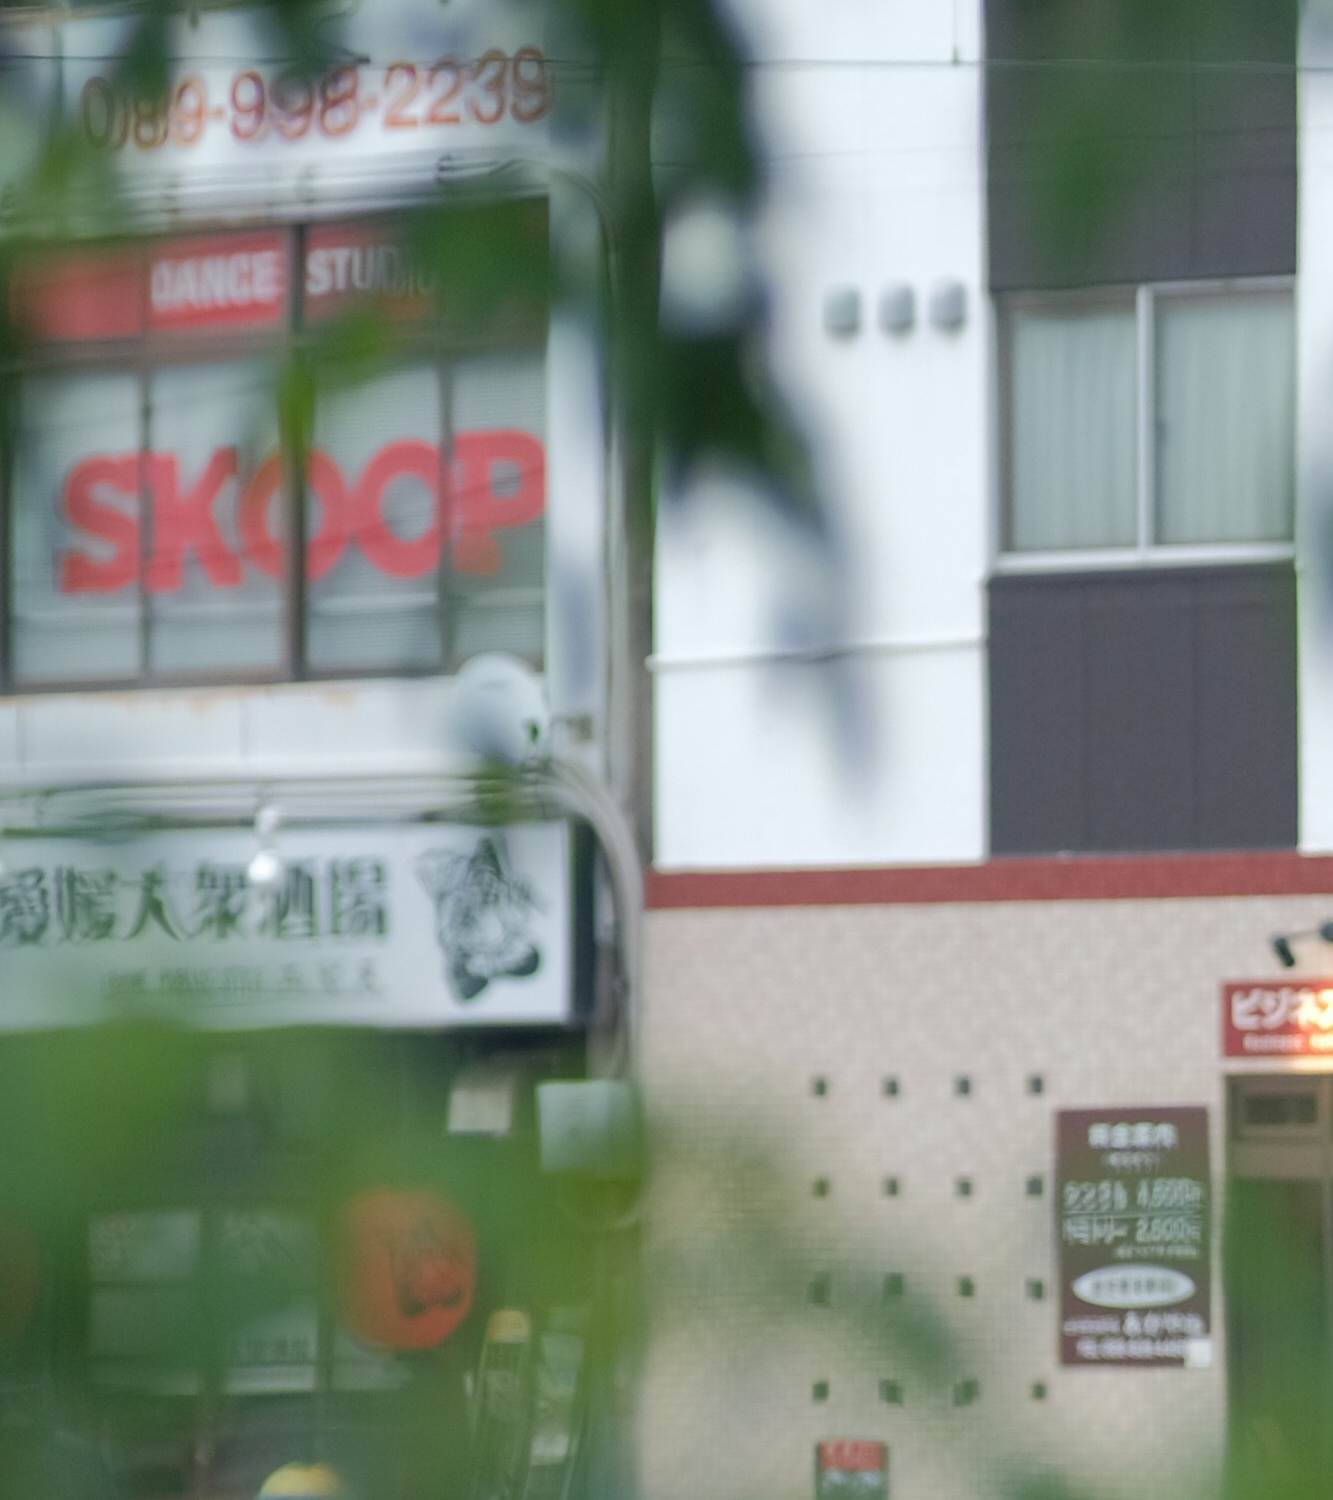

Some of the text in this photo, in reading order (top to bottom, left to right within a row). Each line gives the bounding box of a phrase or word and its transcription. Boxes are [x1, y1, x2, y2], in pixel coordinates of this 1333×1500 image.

[150, 246, 434, 310] DANCE STUD
[60, 428, 546, 592] SKOOP
